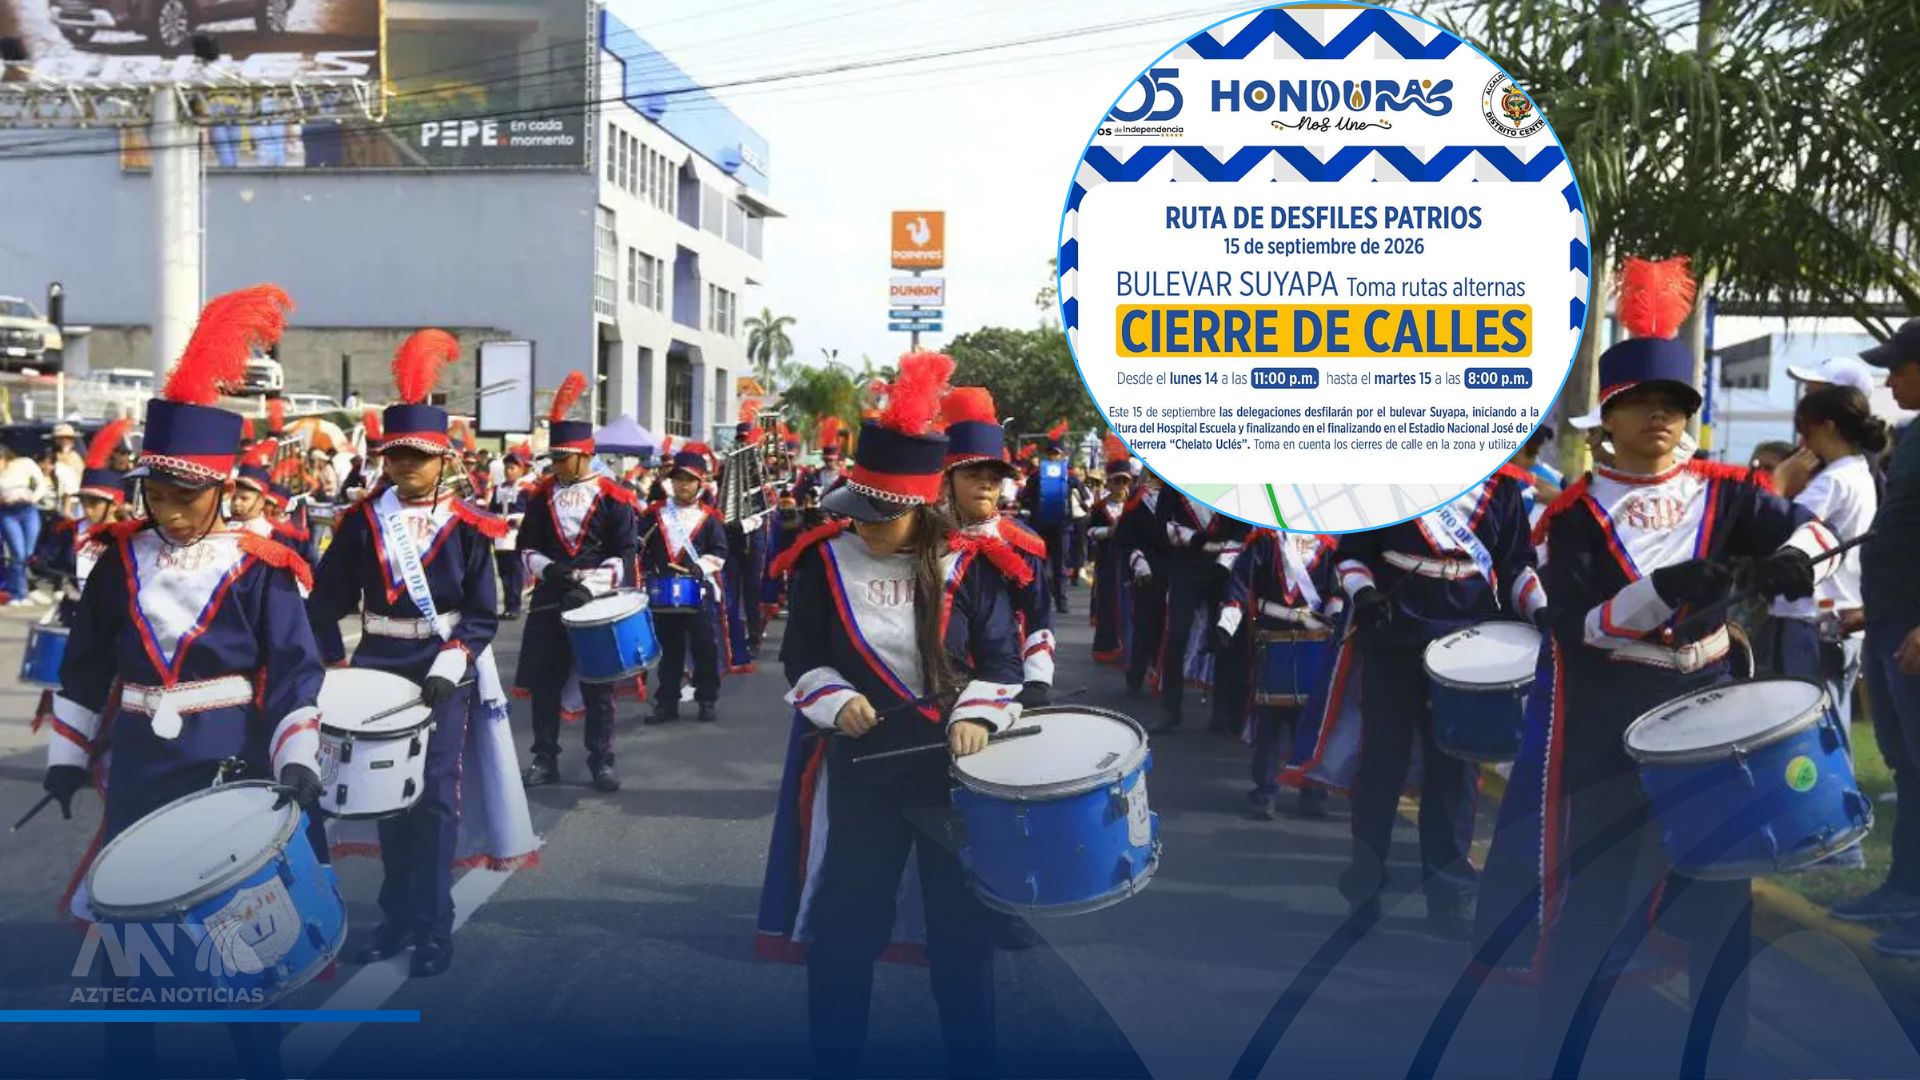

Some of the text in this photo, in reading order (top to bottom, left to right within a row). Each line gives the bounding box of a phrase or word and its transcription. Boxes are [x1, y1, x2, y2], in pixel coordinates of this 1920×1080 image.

[510, 119, 563, 131] En cada
[510, 134, 575, 147] momento
[1627, 496, 1685, 531] SJB
